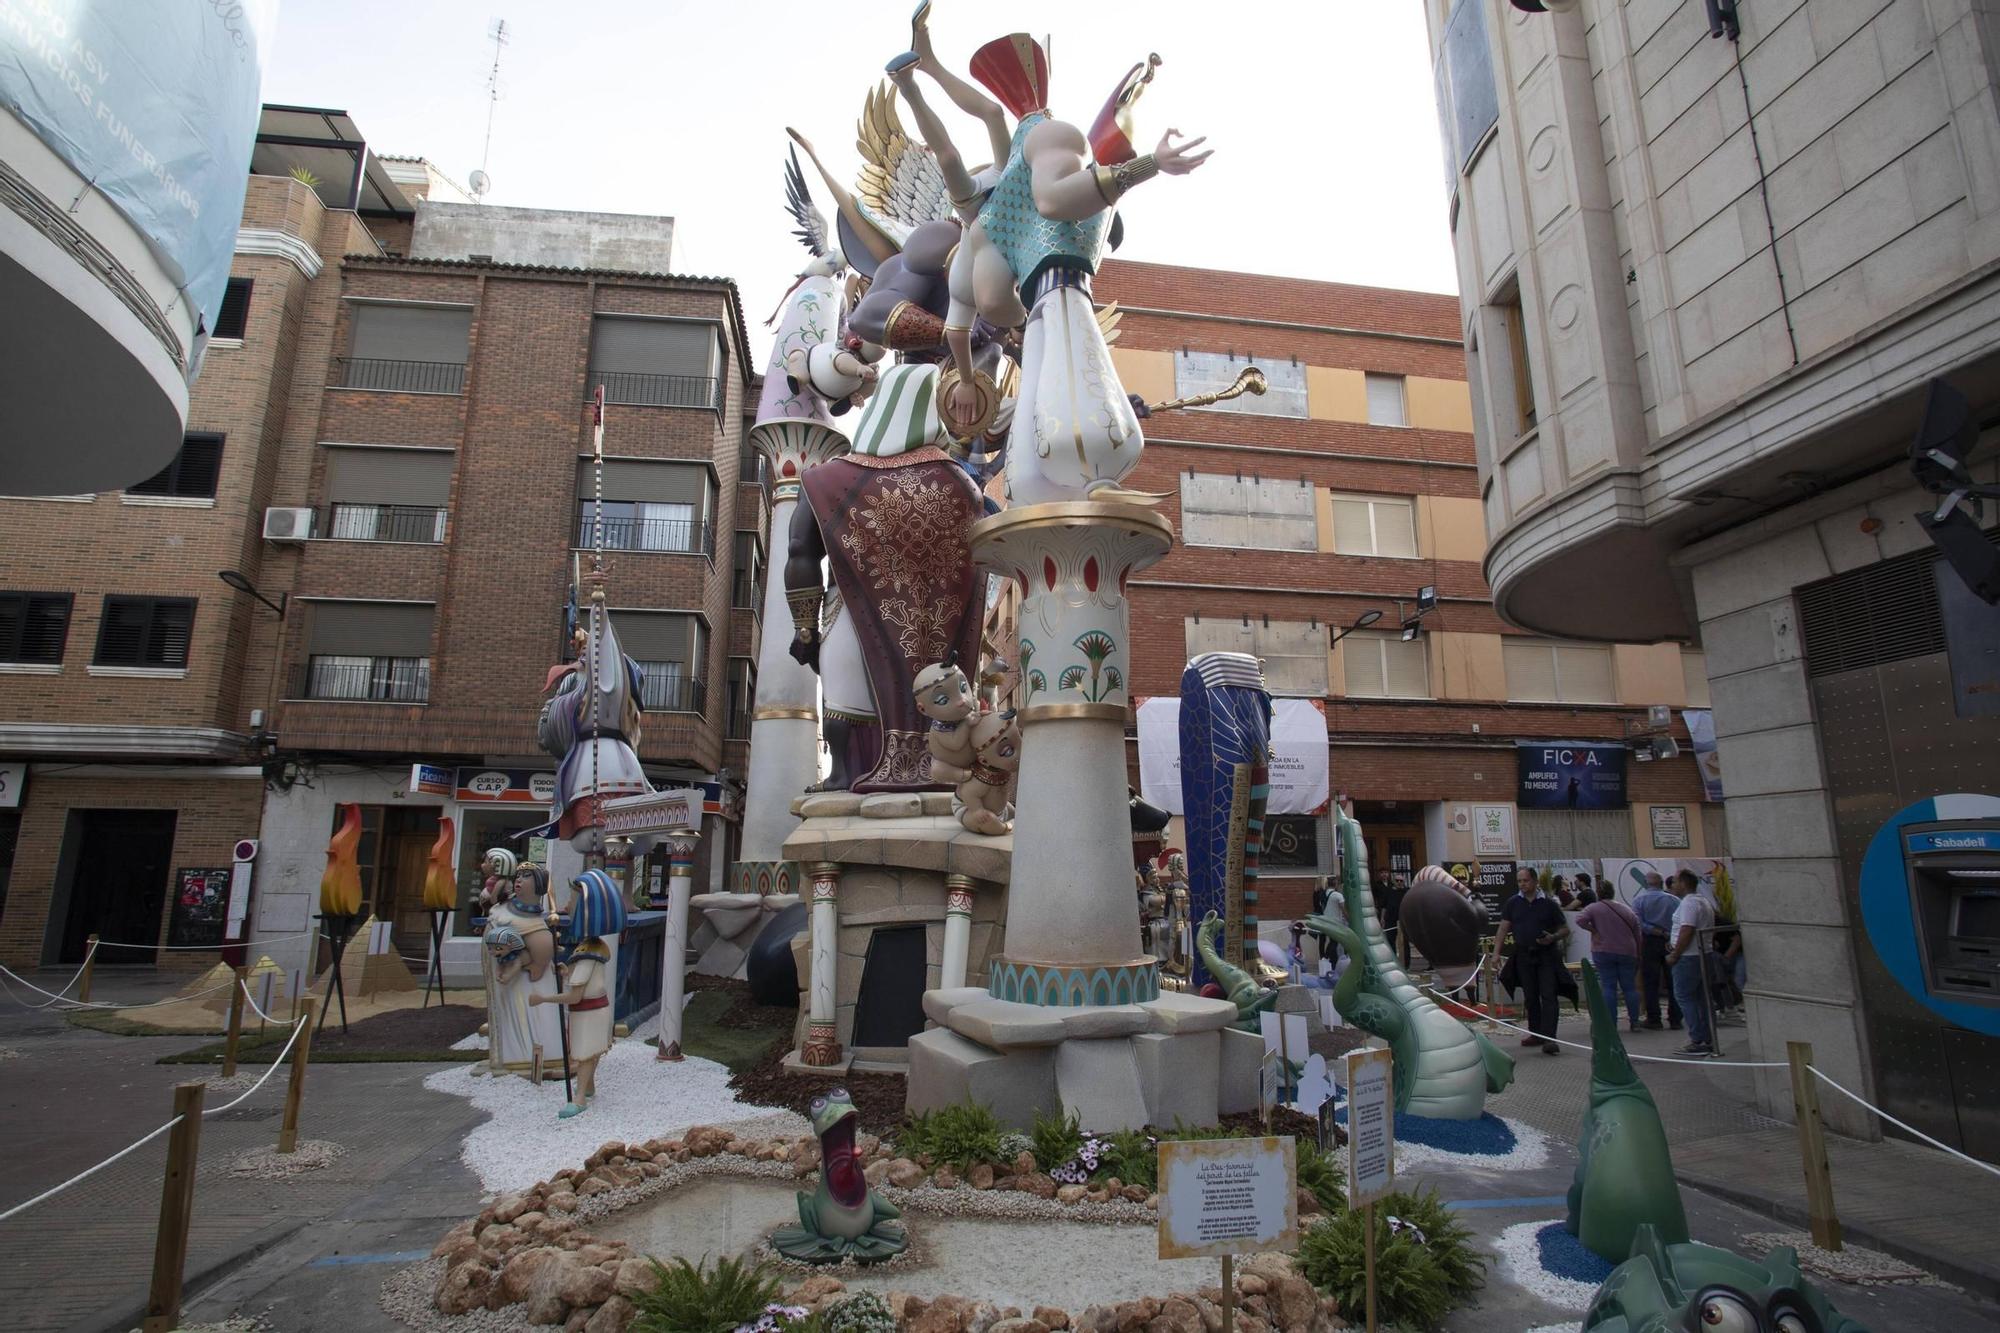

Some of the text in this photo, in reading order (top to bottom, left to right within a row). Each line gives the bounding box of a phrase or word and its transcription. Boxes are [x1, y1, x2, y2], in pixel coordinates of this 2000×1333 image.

[71, 38, 110, 85] ASV
[97, 101, 200, 219] FUNERARIOS
[1524, 781, 1558, 791] TU MENSAJE
[1934, 837, 1985, 847] Sabadell
